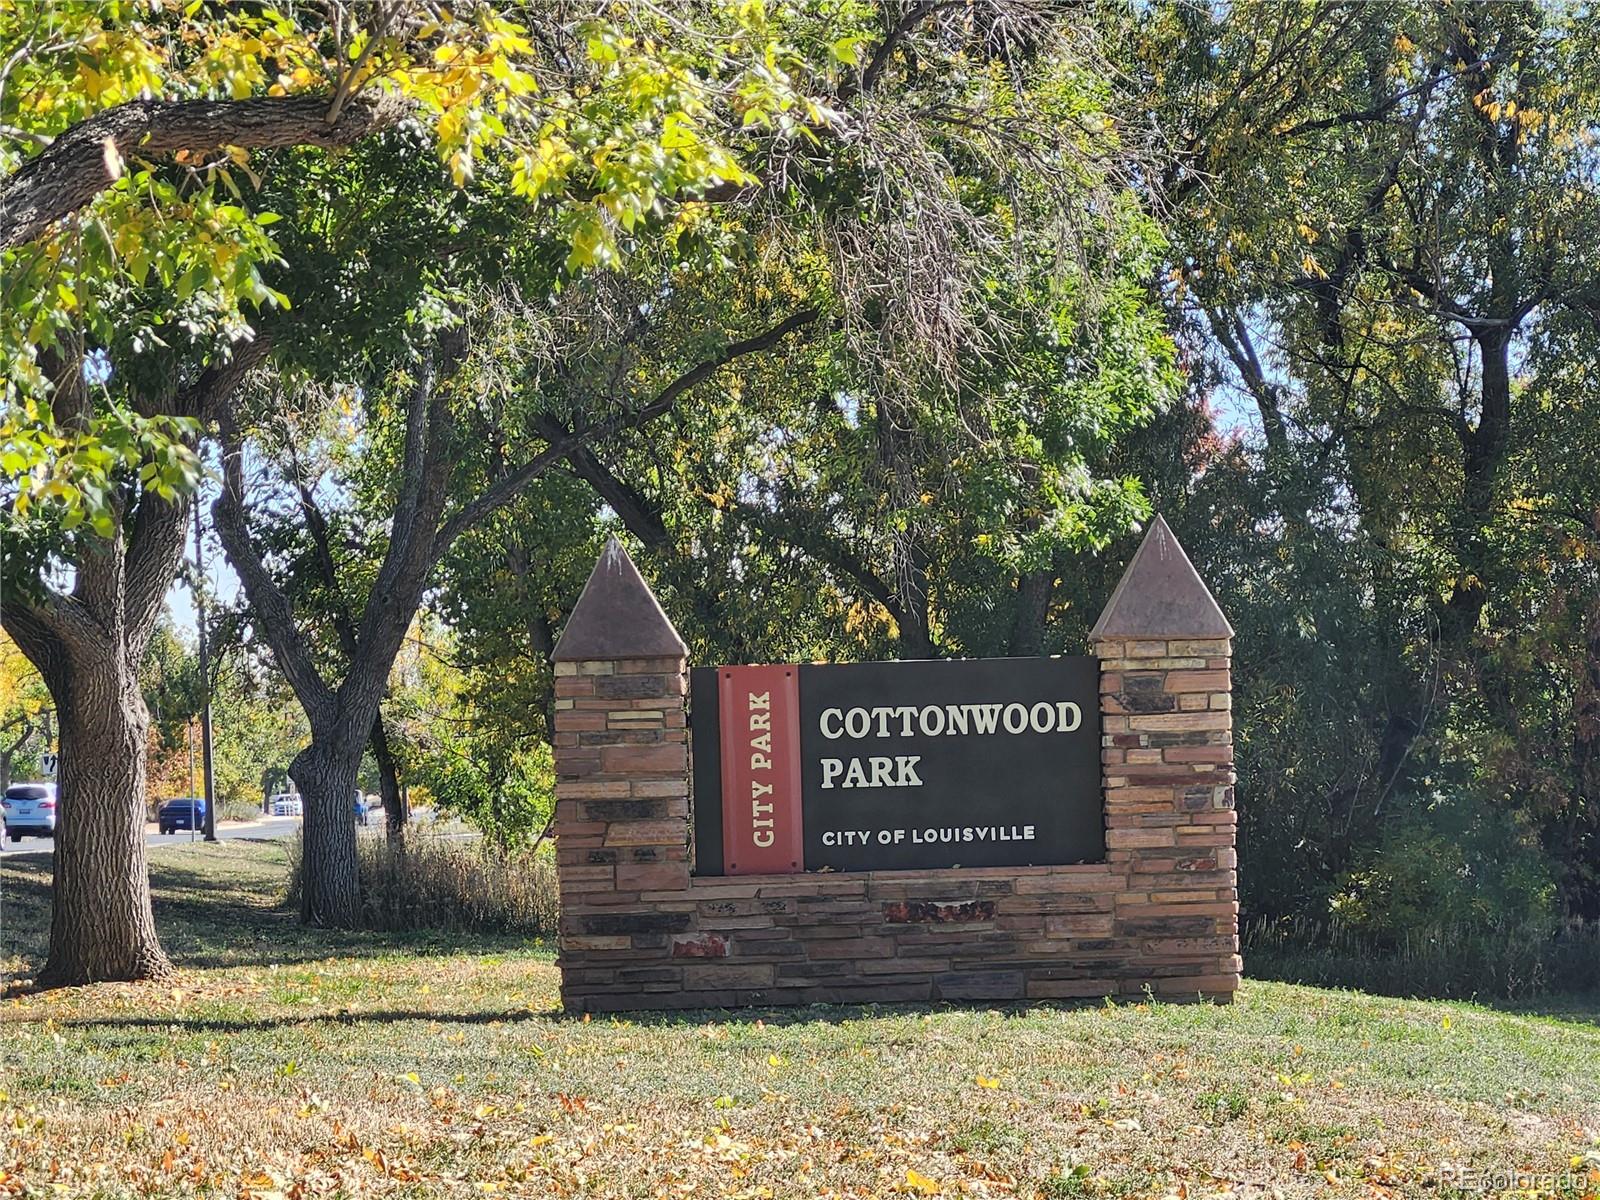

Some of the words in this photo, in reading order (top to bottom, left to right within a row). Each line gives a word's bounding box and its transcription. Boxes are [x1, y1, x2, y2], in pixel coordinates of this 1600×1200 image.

[749, 691, 772, 770] PARK
[819, 702, 1082, 739] COTTONWOOD
[820, 755, 923, 789] PARK
[753, 781, 775, 848] CITY
[822, 830, 871, 846] CITY
[877, 829, 905, 844] OF
[912, 825, 1036, 844] LOUISVILLE
